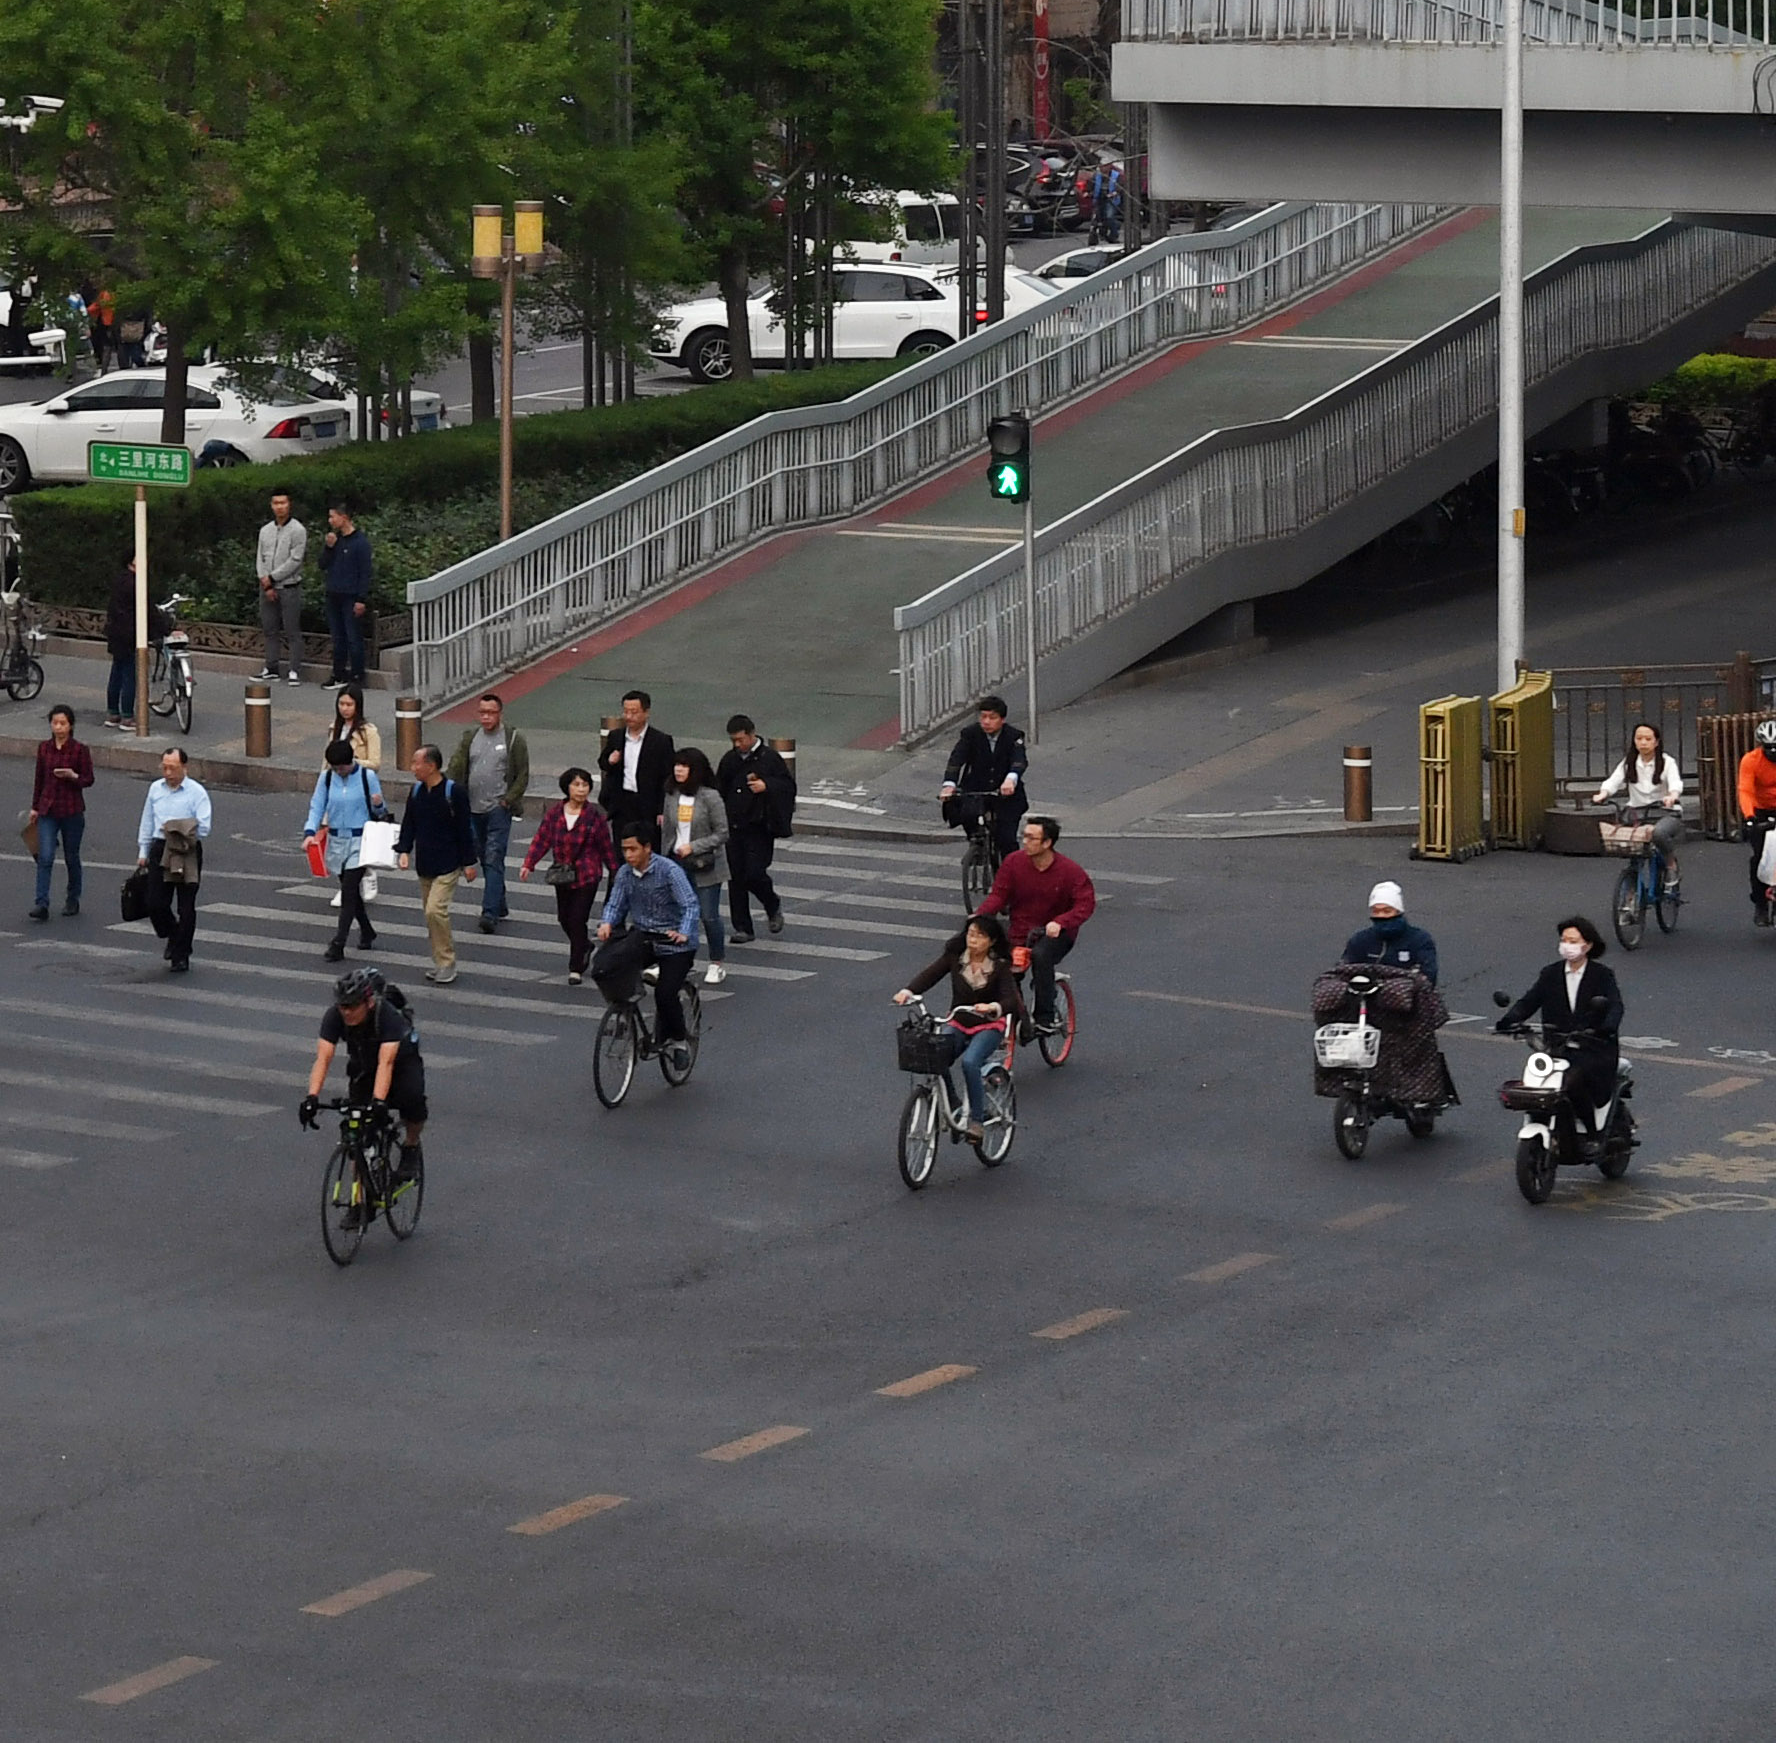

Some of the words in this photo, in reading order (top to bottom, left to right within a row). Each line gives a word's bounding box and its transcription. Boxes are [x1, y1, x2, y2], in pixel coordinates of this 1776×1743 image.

[118, 450, 184, 471] 三里河东路
